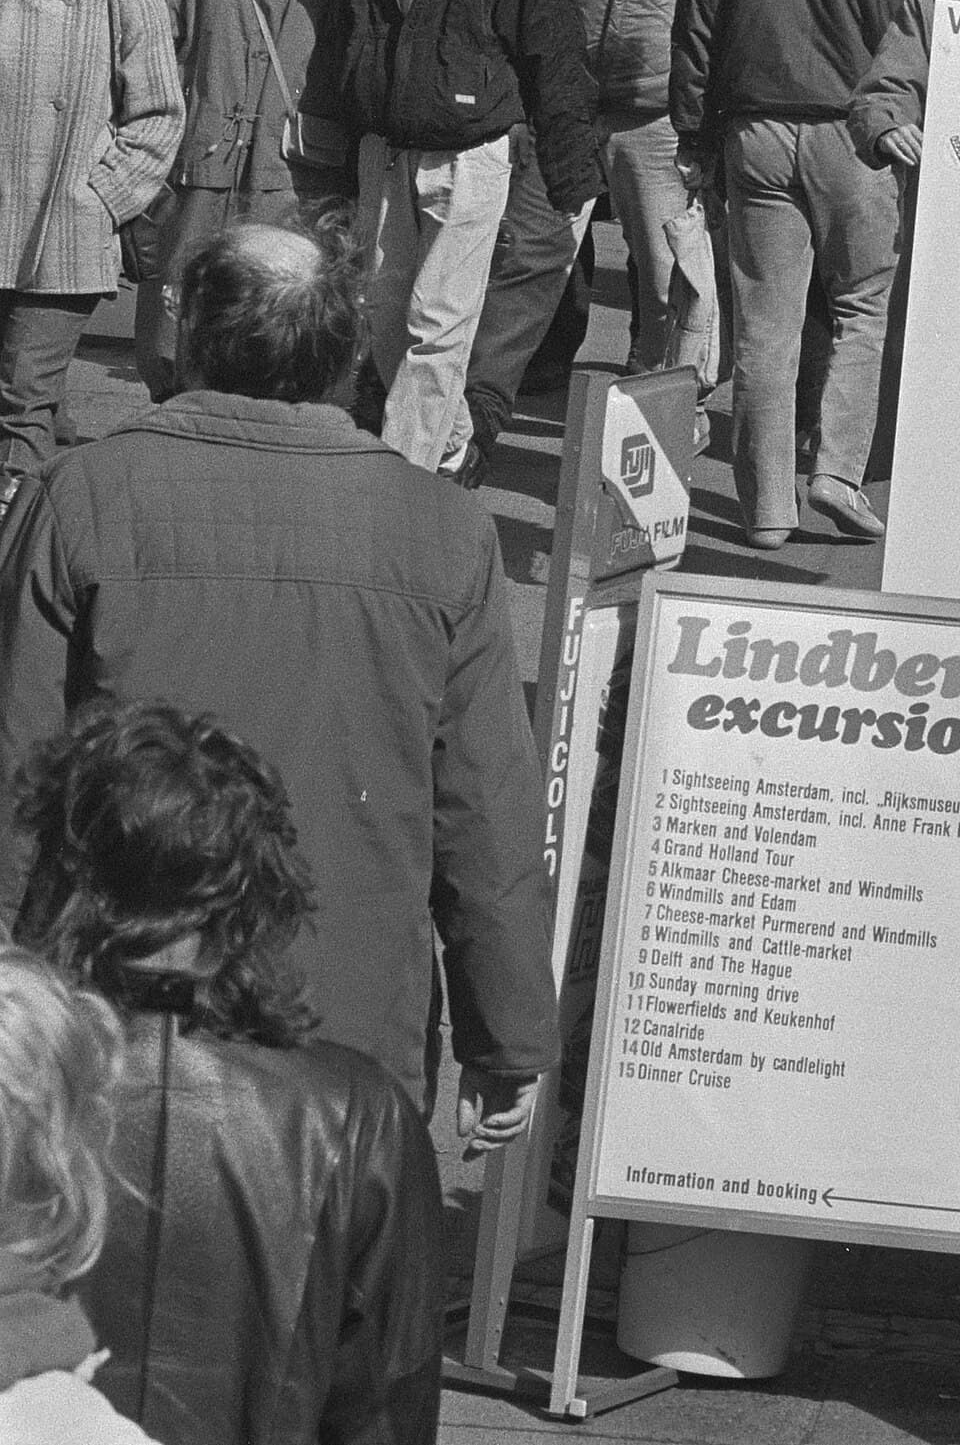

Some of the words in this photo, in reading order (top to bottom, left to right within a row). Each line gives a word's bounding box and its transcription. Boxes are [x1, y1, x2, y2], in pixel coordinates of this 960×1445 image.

[653, 516, 685, 542] FILM
[671, 768, 751, 797] Sightseeing
[841, 786, 869, 806] incl.
[666, 815, 718, 838] Marken
[723, 824, 749, 841] and
[754, 825, 818, 848] Volendam
[663, 838, 704, 859] Grand
[708, 843, 760, 865] Holland
[765, 848, 796, 867] Tour
[659, 883, 724, 905] Windmills
[730, 892, 756, 908] and
[760, 892, 798, 912] Edam
[660, 860, 717, 882] Alkmaar
[721, 866, 822, 893] Cheese-market
[827, 879, 853, 896] and
[858, 880, 924, 903] Windmills
[655, 925, 721, 949] Windmills
[727, 935, 754, 952] and
[761, 937, 853, 962] Cattle-market
[656, 903, 756, 930] Cheese-market
[761, 914, 836, 938] Purmerend
[841, 924, 867, 942] and
[872, 925, 938, 949] Windmills
[648, 972, 698, 997] Sunday
[704, 981, 760, 1004] morning
[766, 985, 800, 1004] drive
[643, 1019, 706, 1042] Canalride
[646, 995, 727, 1020] Flowerfields
[733, 1007, 759, 1024] and
[763, 1008, 836, 1032] Keukenhof
[638, 1063, 683, 1084] Dinner
[688, 1068, 732, 1090] Cruise
[641, 1040, 663, 1059] Old
[667, 1042, 744, 1067] Amsterdam
[749, 1051, 766, 1073] by
[772, 1056, 846, 1080] candlelight
[625, 1165, 716, 1191] Information
[721, 1178, 751, 1195] and
[756, 1179, 827, 1206] booking
